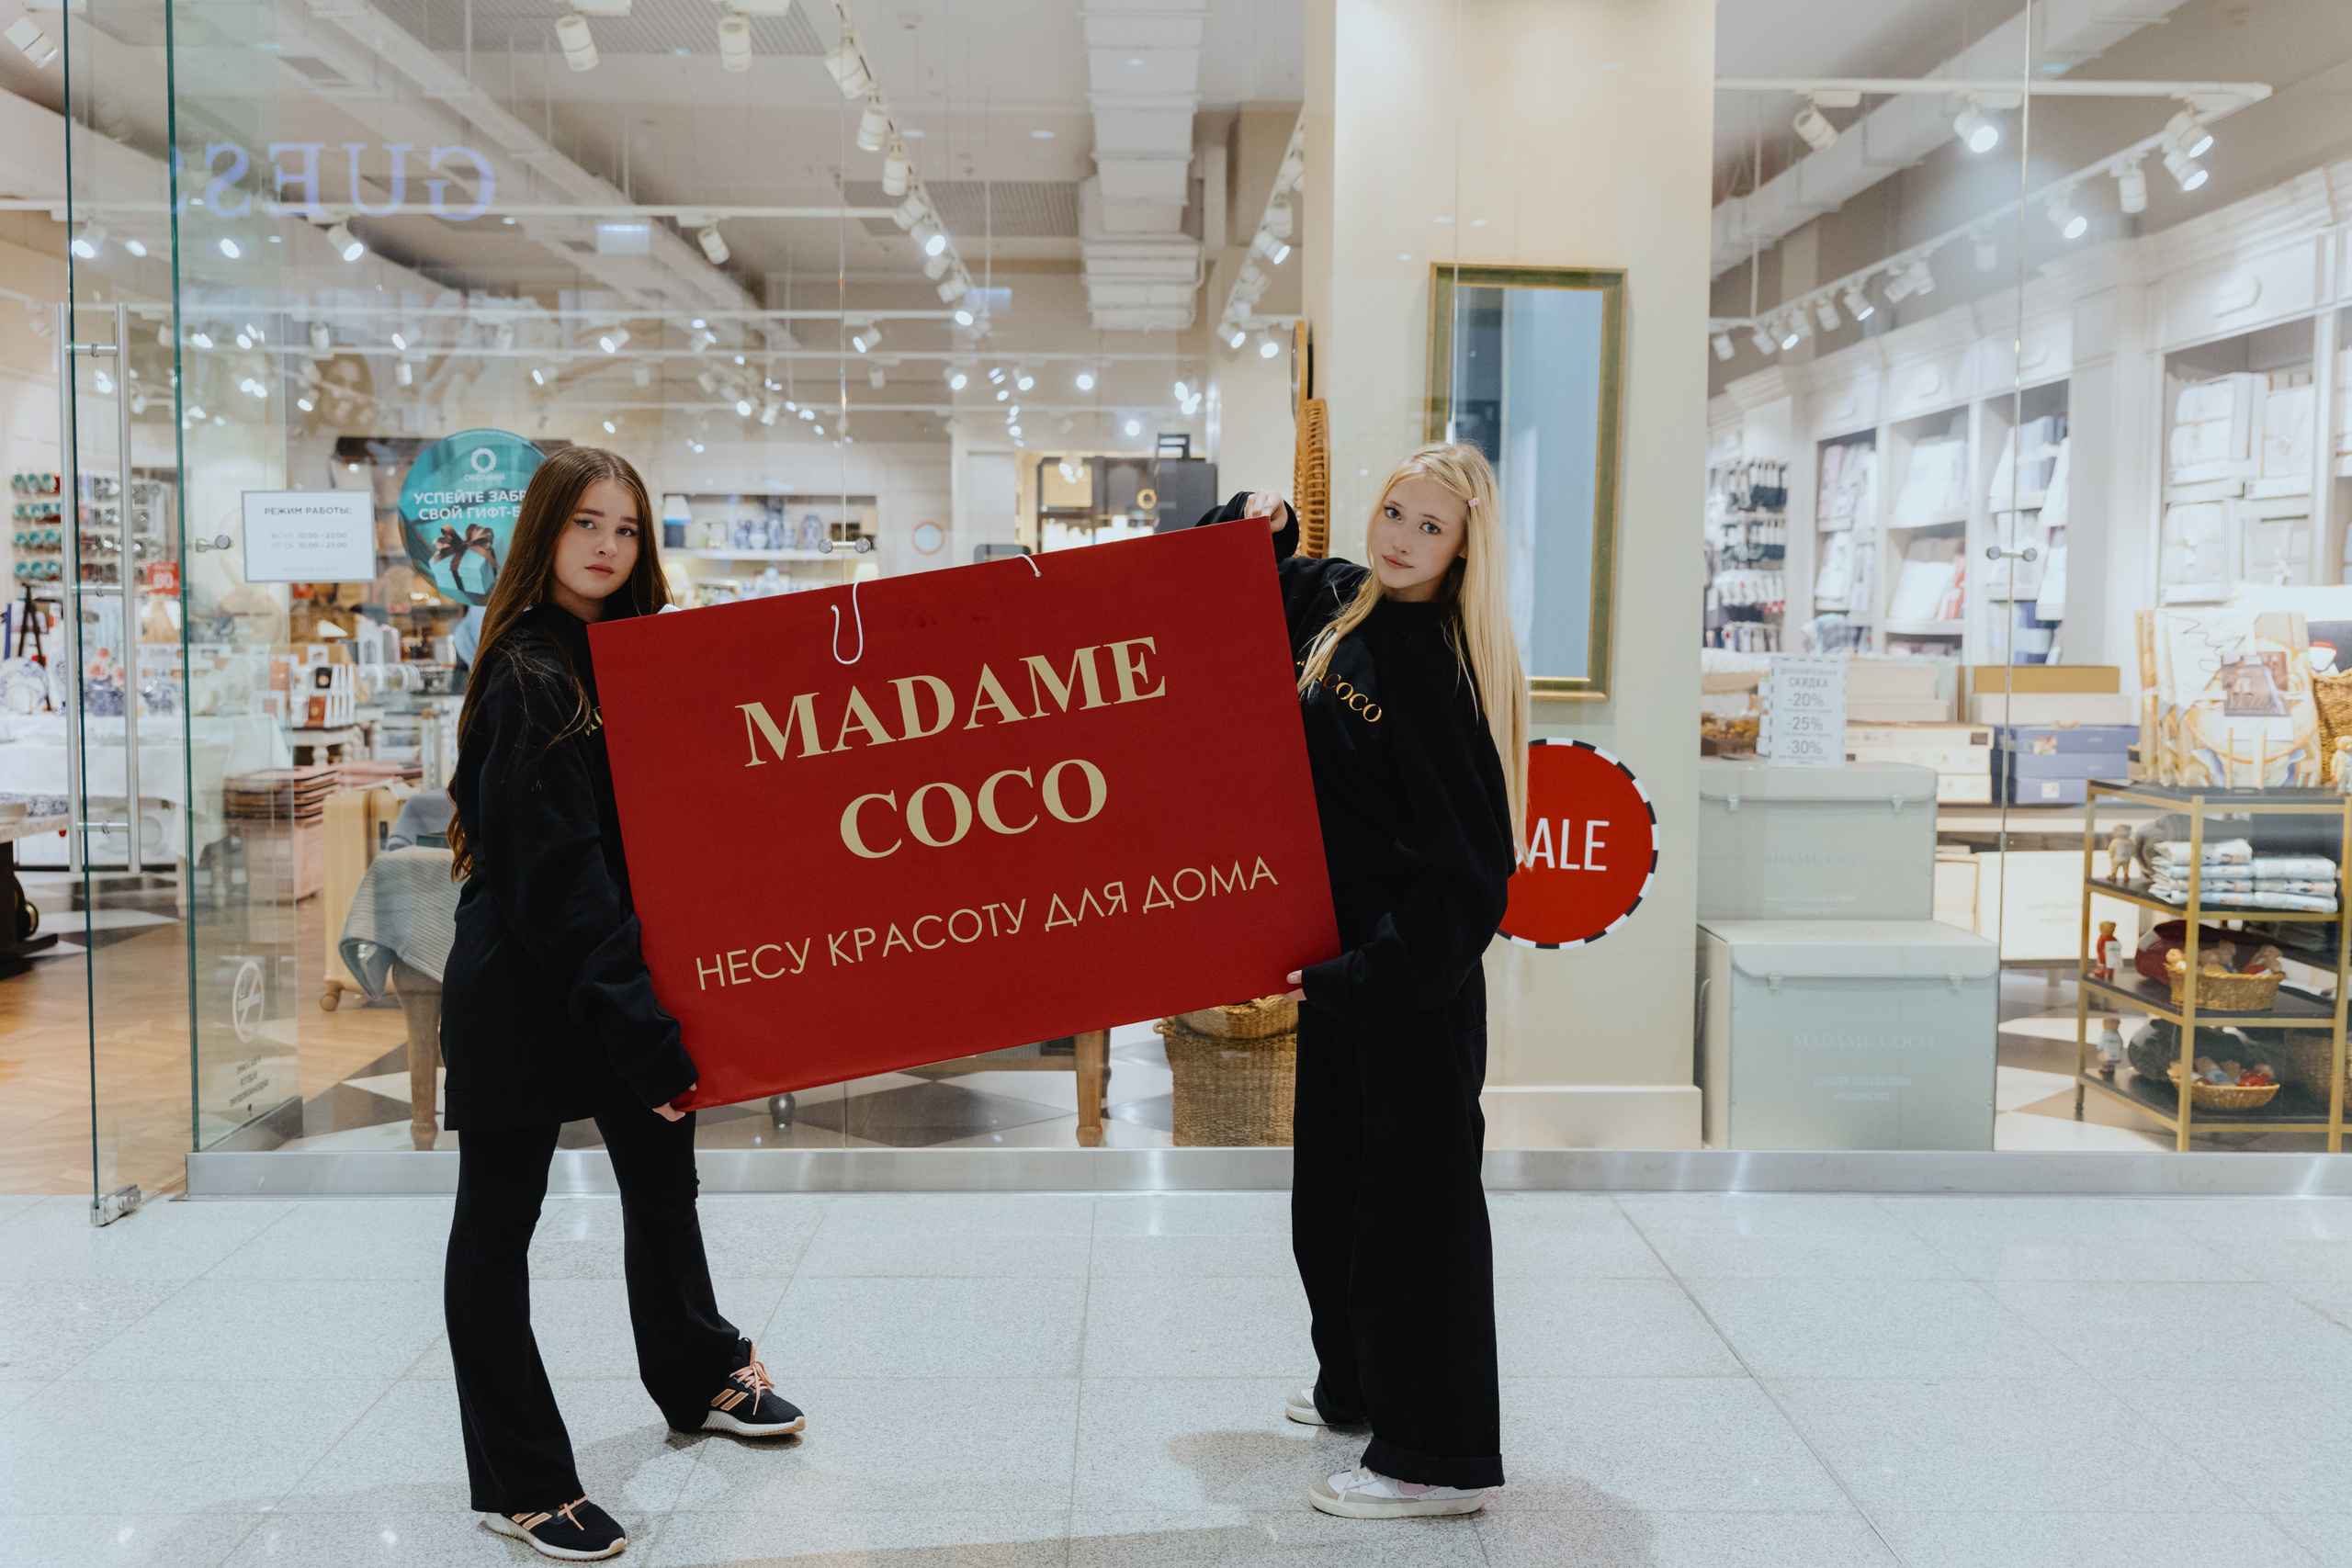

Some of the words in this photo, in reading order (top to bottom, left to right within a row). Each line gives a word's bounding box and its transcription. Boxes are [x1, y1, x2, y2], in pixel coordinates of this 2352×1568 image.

[464, 473, 505, 482] ОКЕАНИЯ
[414, 490, 484, 504] УСПЕЙТЕ
[488, 490, 526, 502] ЗАБР
[265, 507, 303, 515] РЕЖИМ
[305, 506, 353, 514] РАБОТЫ:
[418, 505, 463, 520] СВОЙ
[467, 505, 521, 519] ГИФТ-Б
[1788, 677, 1829, 688] СКИДКА
[735, 637, 1165, 766] MADAME
[1324, 673, 1382, 723] COCO
[1788, 693, 1825, 707] -20%
[1788, 716, 1824, 731] -25%
[1786, 739, 1823, 755] -30%
[841, 760, 1106, 858] COCO
[1766, 852, 1822, 866] ADAME
[696, 938, 810, 990] НЕСУ
[828, 899, 1025, 965] КРАСОТУ
[1045, 882, 1127, 931] ДЛЯ
[1143, 856, 1278, 913] ДОМА
[1792, 1033, 1874, 1048] MADAME
[1879, 1033, 1935, 1048] COCO
[1813, 1077, 1849, 1087] LUXURY
[1852, 1077, 1911, 1087] COLLECTION
[1874, 1092, 1891, 1100] SET
